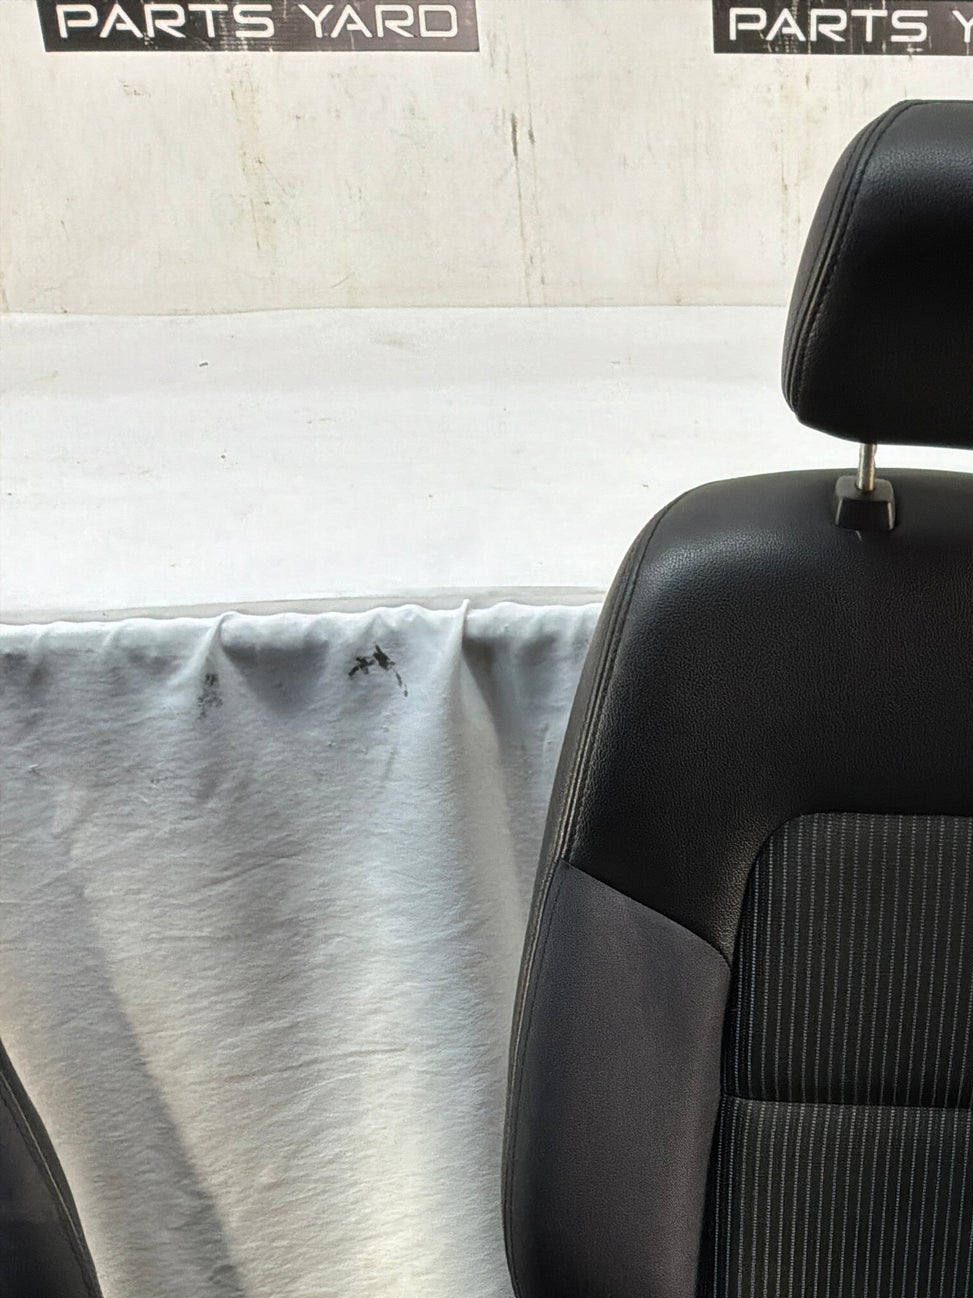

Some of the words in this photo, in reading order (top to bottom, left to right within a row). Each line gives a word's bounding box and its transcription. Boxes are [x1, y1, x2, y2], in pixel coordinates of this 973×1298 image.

[57, 4, 275, 38] PARTS
[298, 4, 458, 39] YARD
[728, 7, 929, 43] PARTS
